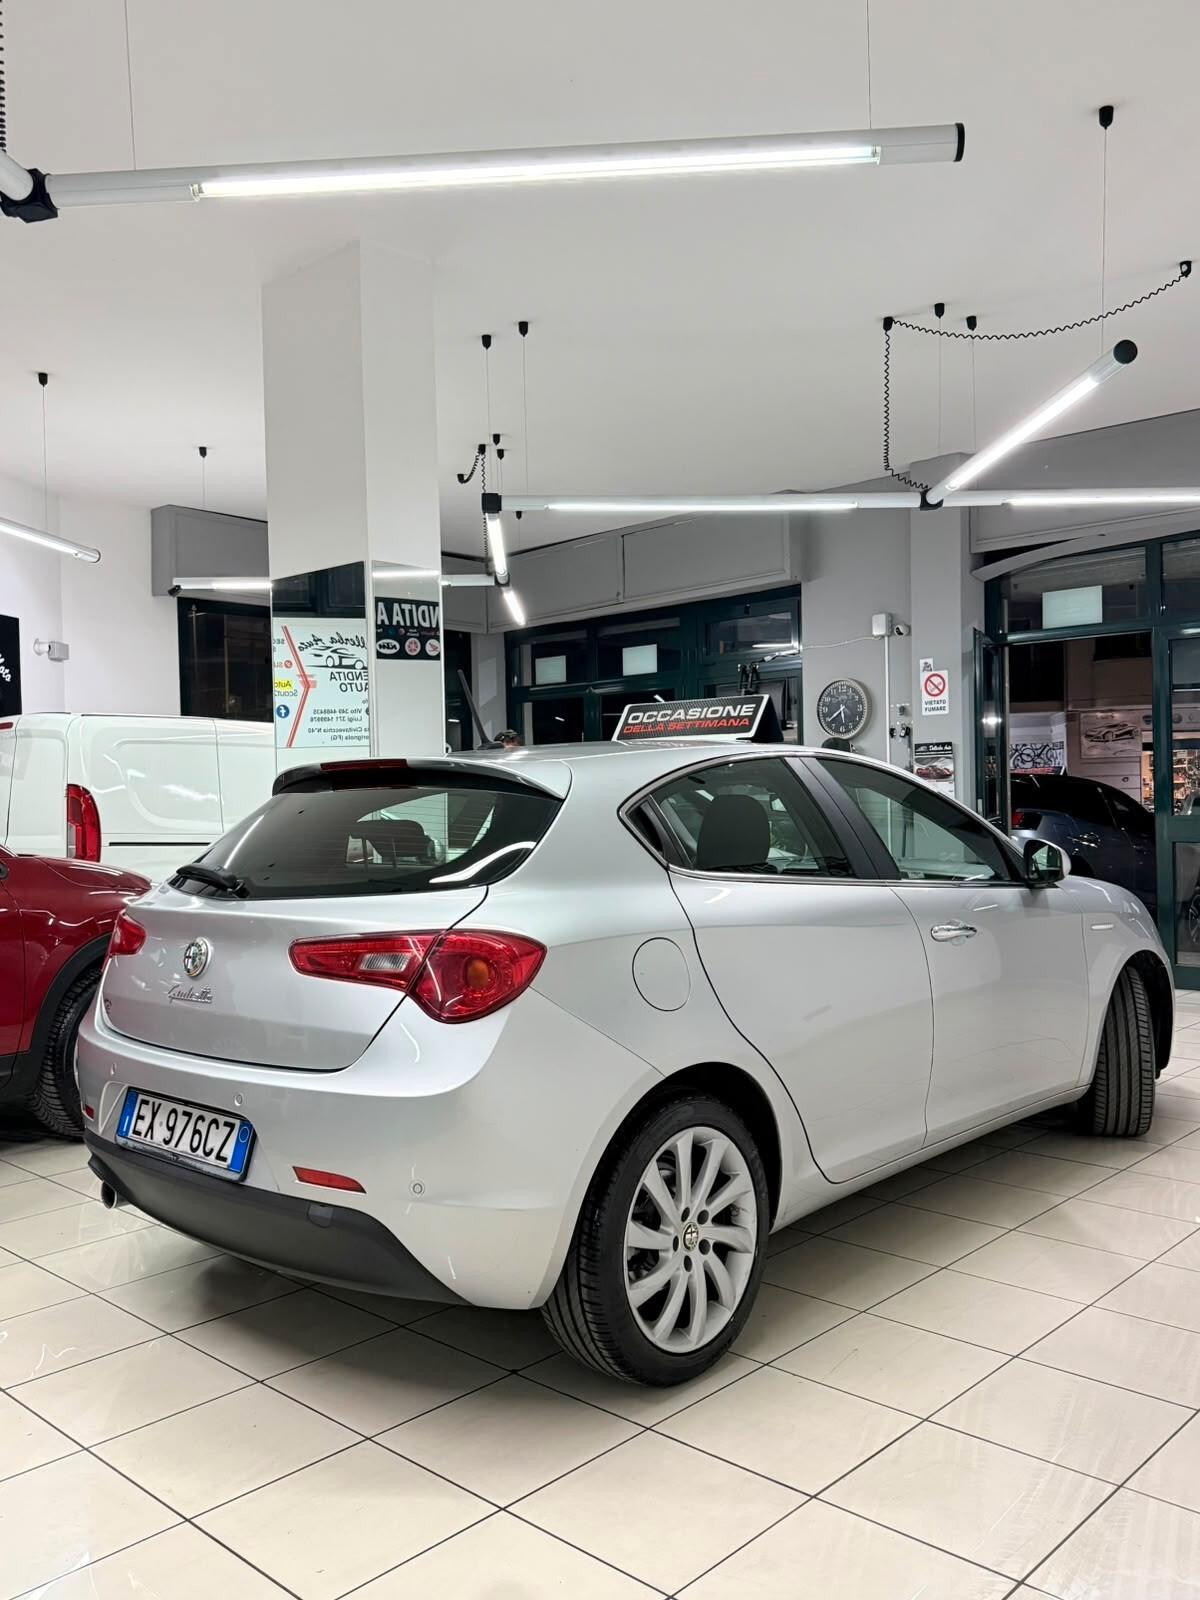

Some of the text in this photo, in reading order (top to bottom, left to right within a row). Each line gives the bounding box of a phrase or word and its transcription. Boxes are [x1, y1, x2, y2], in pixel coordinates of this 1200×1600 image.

[628, 704, 756, 724] OCCASIONE
[623, 718, 750, 734] DELLA SETTIMANA
